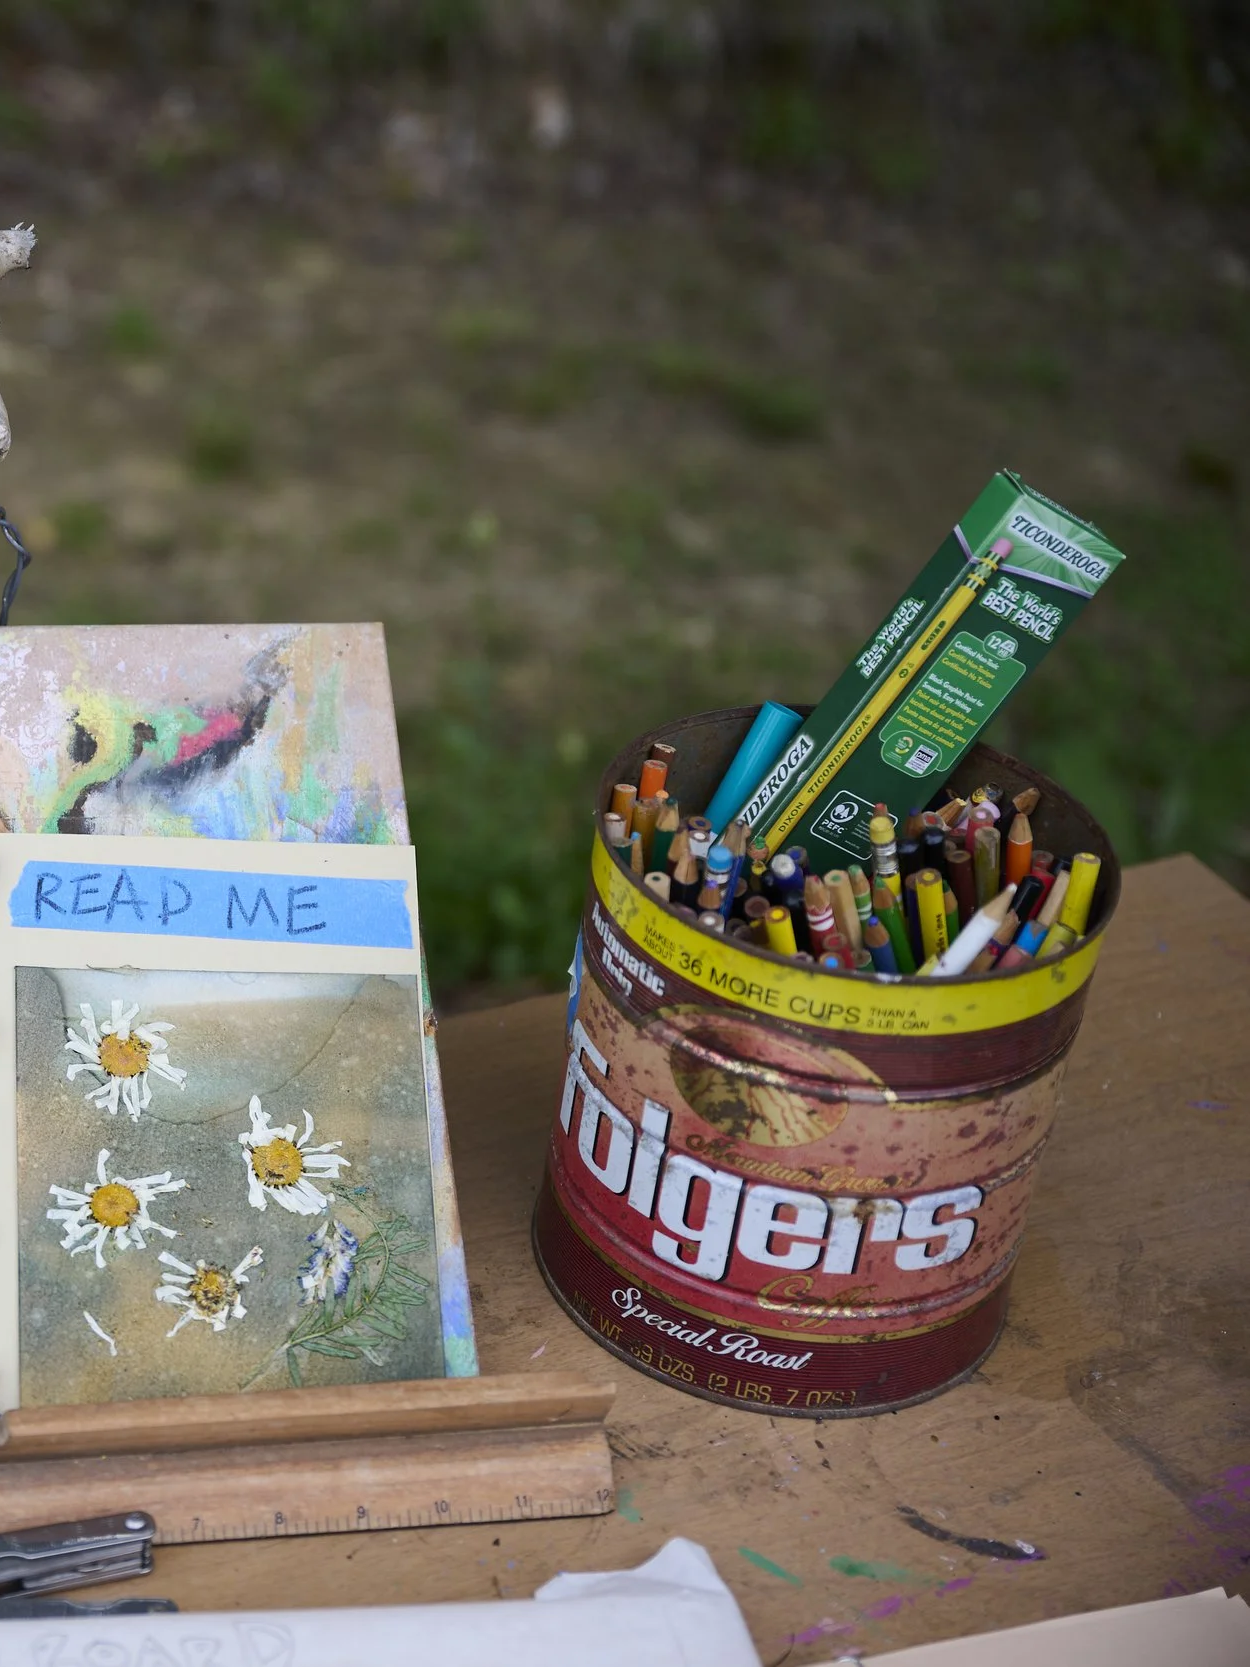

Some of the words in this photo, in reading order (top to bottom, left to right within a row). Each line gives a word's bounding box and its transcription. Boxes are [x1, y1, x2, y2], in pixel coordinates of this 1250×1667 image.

[1011, 515, 1107, 579] TICONDEROGA
[982, 592, 1017, 617] BEST
[1012, 609, 1056, 641] PENCIL
[997, 580, 1020, 602] The
[1023, 594, 1061, 626] World's
[858, 644, 881, 667] The
[878, 600, 914, 641] World's
[864, 643, 888, 676] BEST
[887, 602, 925, 646] PENCIL
[987, 635, 1002, 650] 12
[779, 802, 804, 832] DIXON
[821, 819, 845, 834] PEFC
[35, 868, 192, 926] READ
[227, 884, 327, 935] ME
[592, 901, 665, 997] Automatic
[643, 935, 674, 961] ABOUT
[645, 924, 677, 951] MAKES
[679, 951, 703, 977] 36
[709, 966, 780, 1009] MORE
[789, 996, 862, 1026] CUPS
[870, 1006, 906, 1018] THAN
[908, 1008, 918, 1018] A
[902, 1020, 930, 1031] CAN
[559, 1019, 986, 1283] Folgers
[611, 1287, 717, 1347] Special
[707, 1332, 814, 1371] Roast
[658, 1354, 698, 1385] OZS.
[708, 1372, 729, 1393] (2
[735, 1379, 775, 1404] LBS.
[786, 1389, 799, 1406] 7
[192, 1517, 201, 1532] 7
[274, 1510, 285, 1525] 8
[356, 1505, 367, 1520] 9
[434, 1500, 449, 1514] 10
[515, 1495, 528, 1509] 11
[597, 1488, 610, 1502] 12
